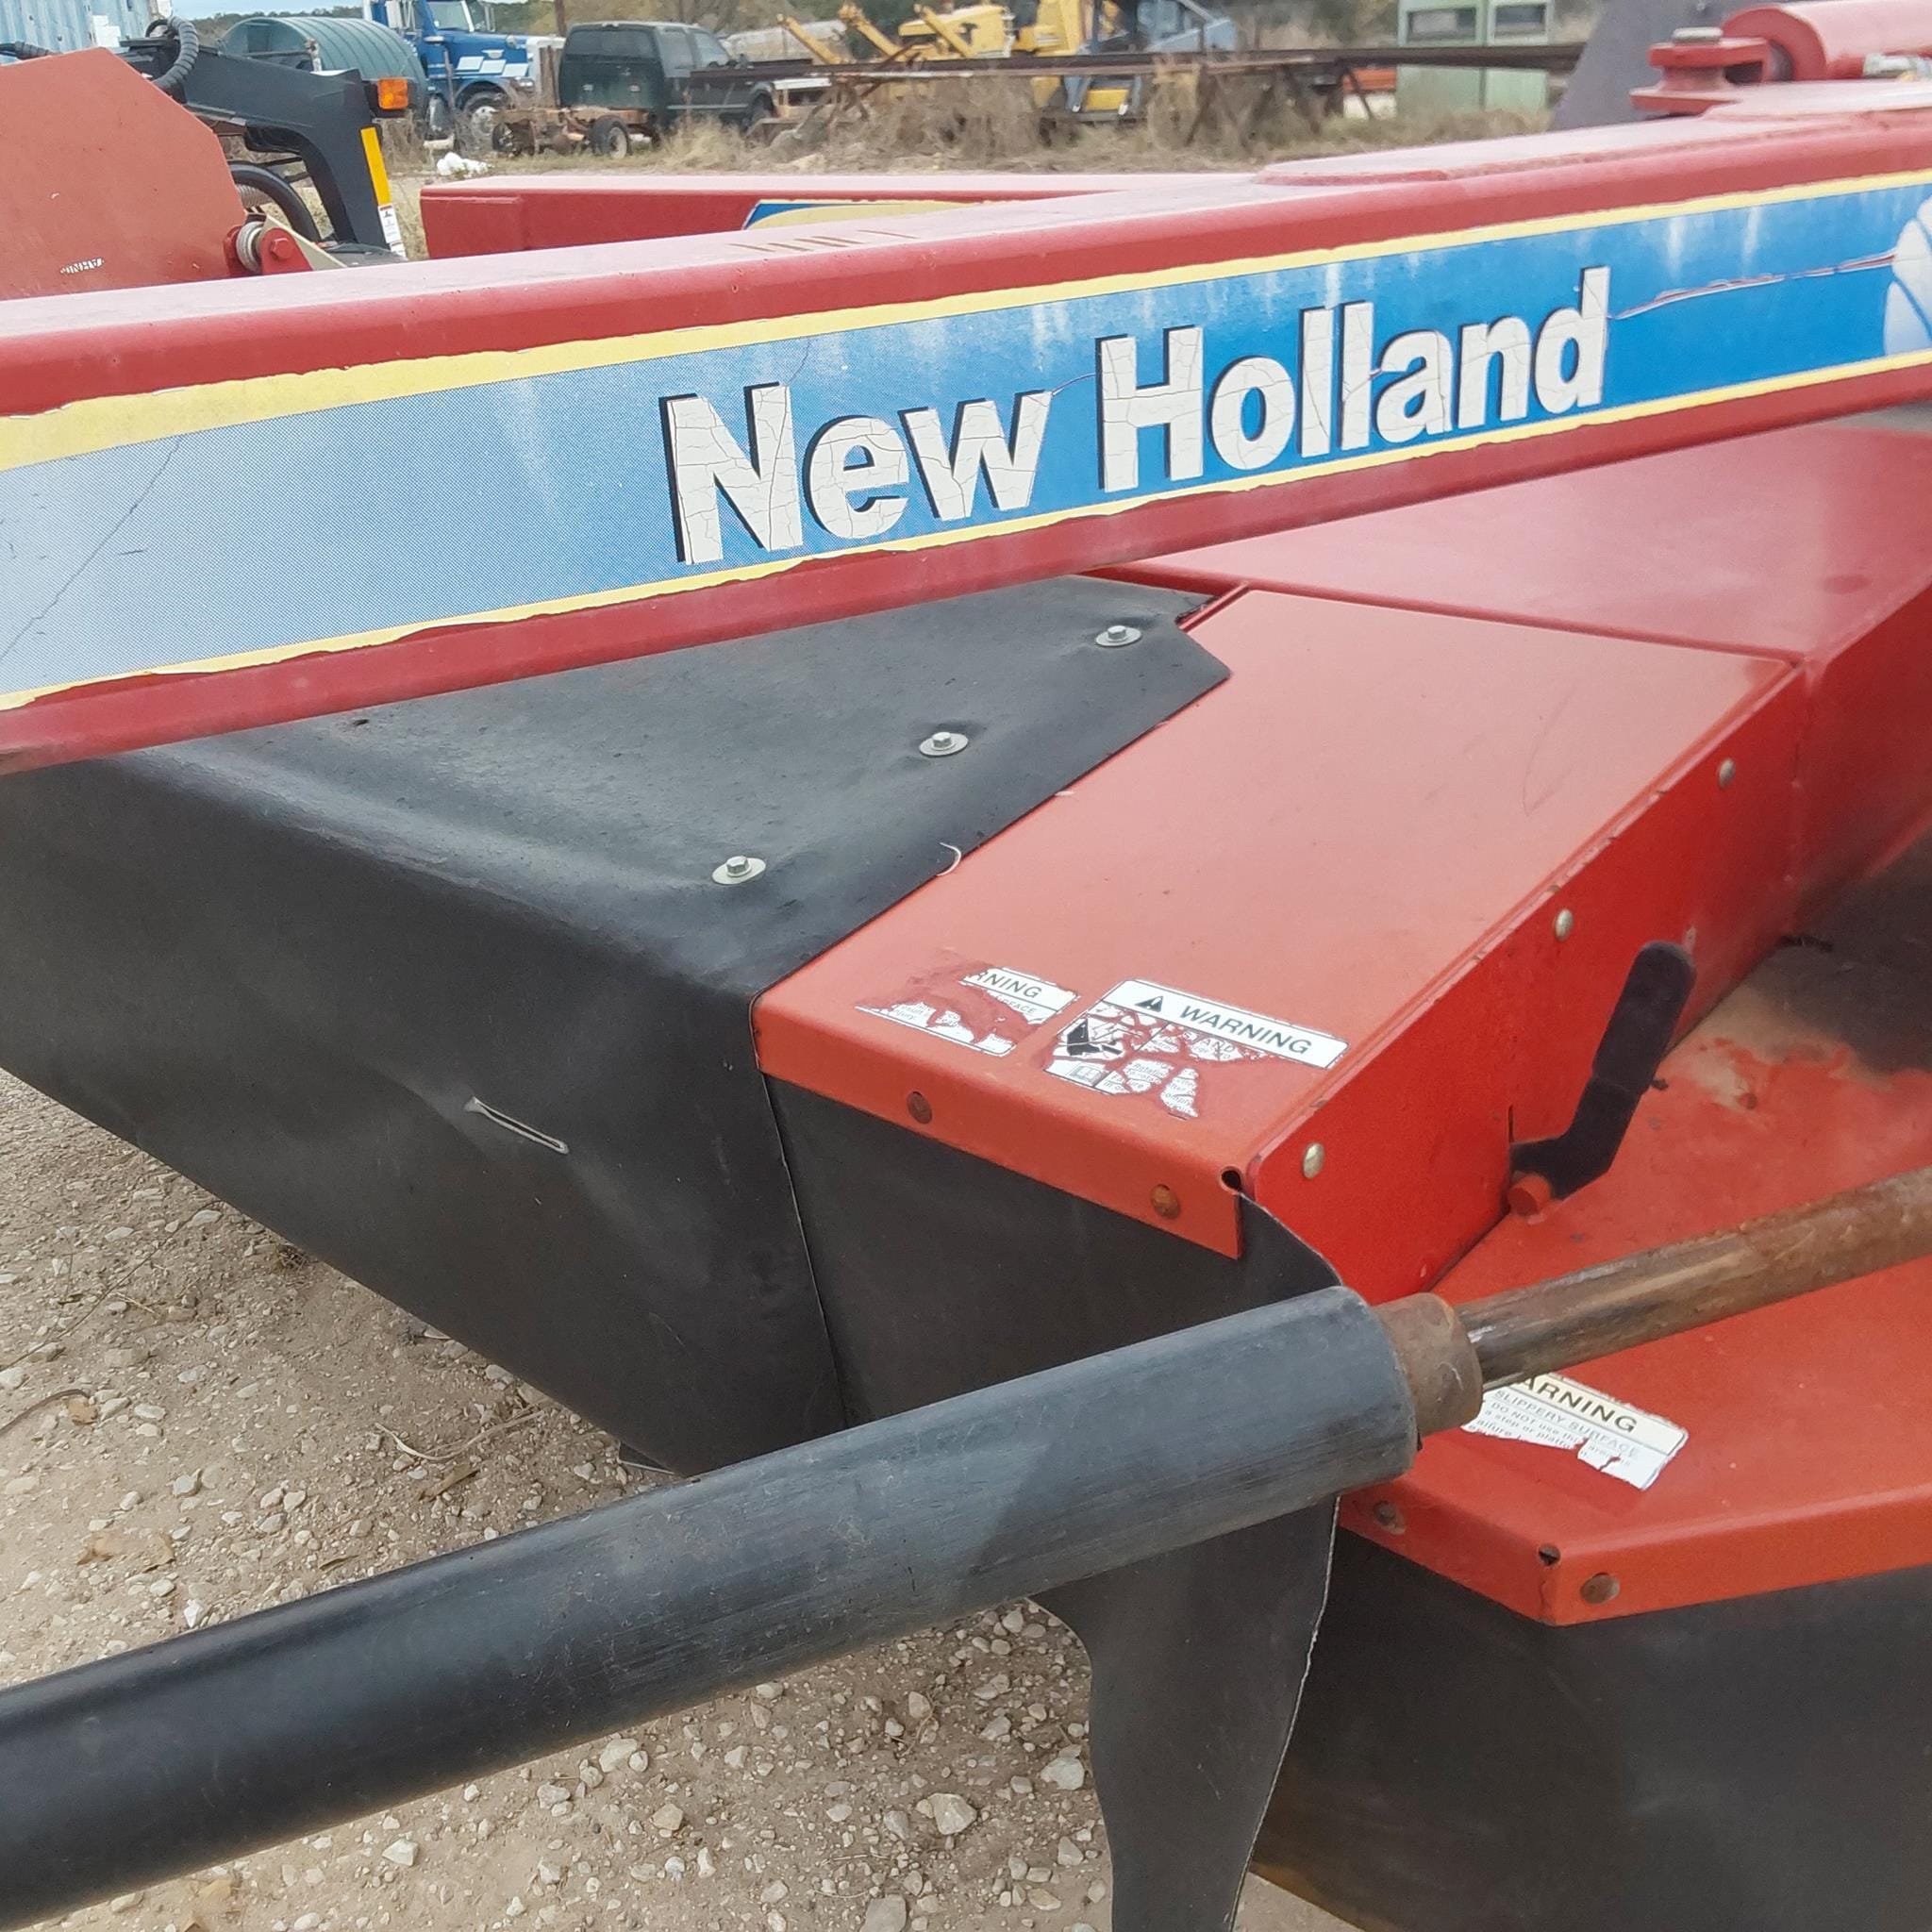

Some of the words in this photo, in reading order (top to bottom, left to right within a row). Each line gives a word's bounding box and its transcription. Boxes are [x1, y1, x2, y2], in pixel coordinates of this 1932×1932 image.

[663, 382, 1055, 565] New
[1096, 266, 1610, 492] Holland
[976, 972, 1042, 998] RNING
[1180, 1005, 1312, 1055] WARNING
[1494, 1390, 1565, 1424] SLIPPERY
[1569, 1421, 1640, 1457] SURFACE
[1523, 1374, 1637, 1432] ARNING
